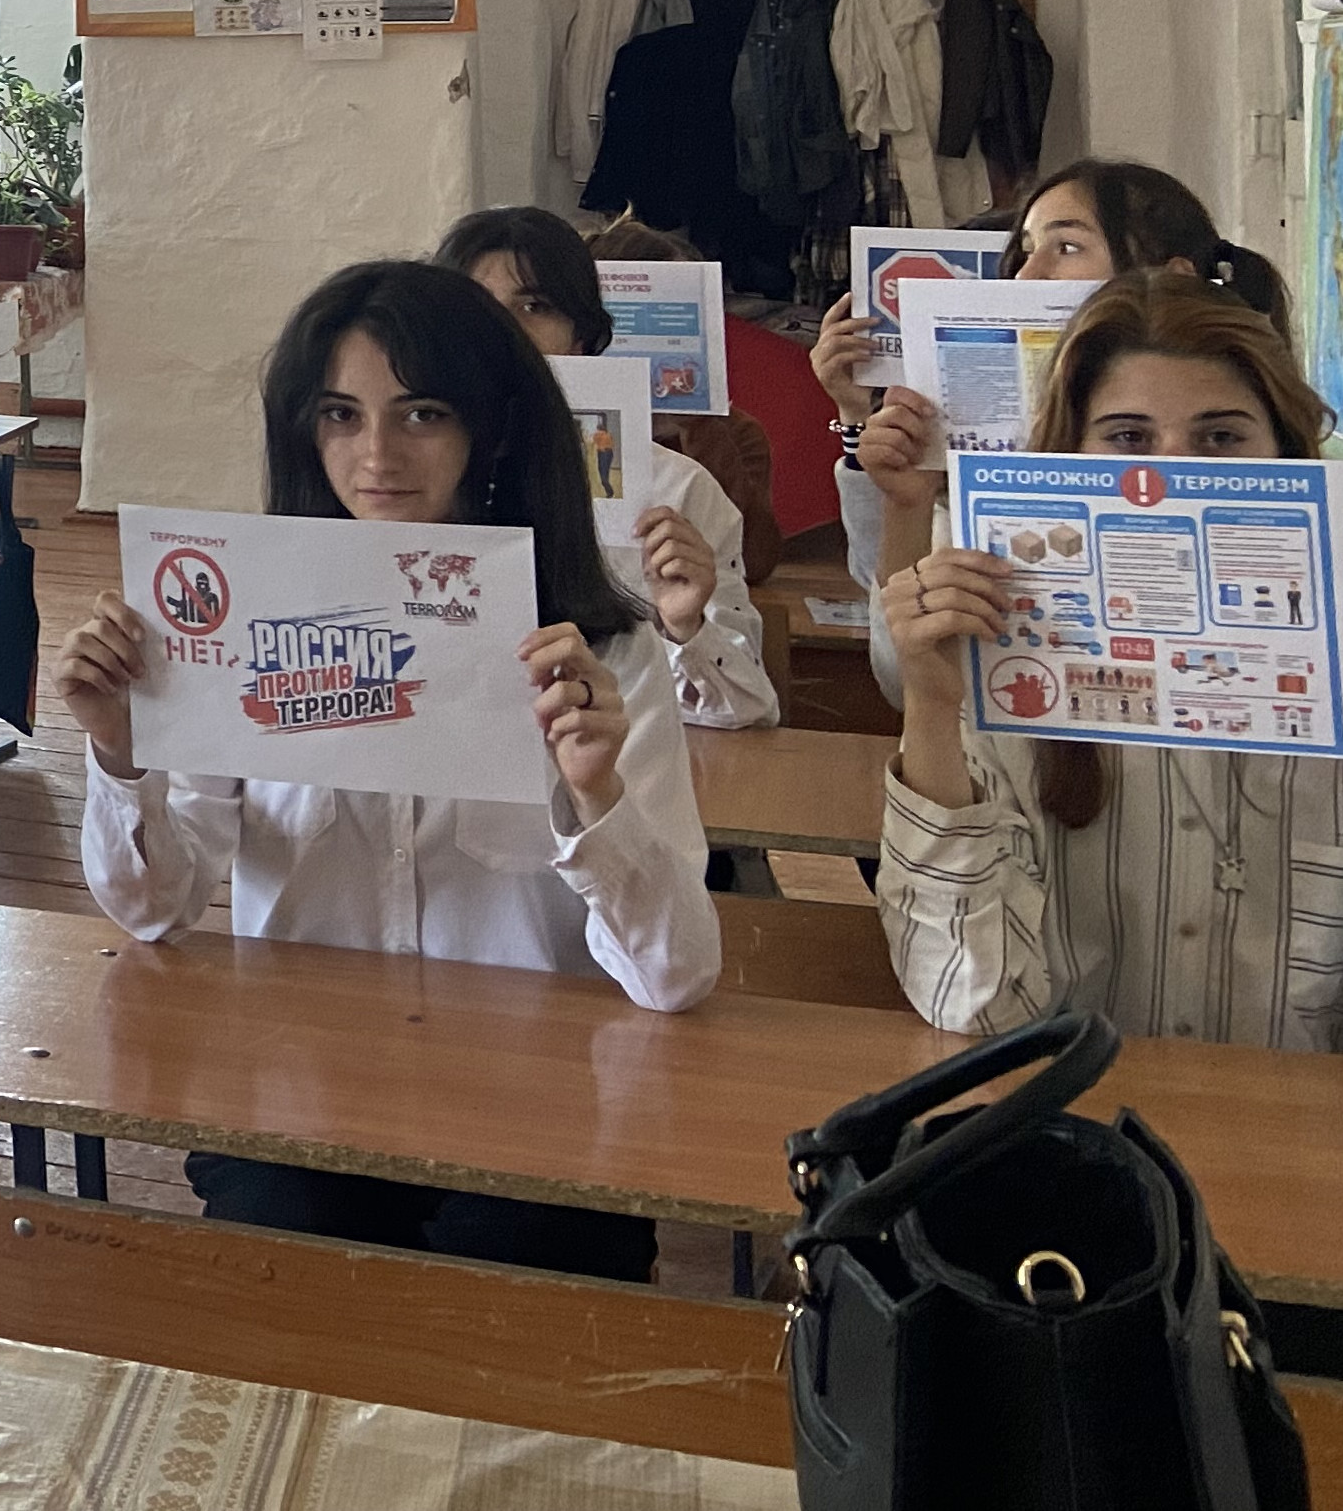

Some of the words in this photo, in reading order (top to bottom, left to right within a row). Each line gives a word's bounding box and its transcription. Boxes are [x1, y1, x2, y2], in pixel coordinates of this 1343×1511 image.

[975, 468, 1114, 488] ОСТОРОЖНО
[1171, 473, 1310, 494] ТЕРРОРИЗМ
[150, 531, 227, 548] ТЕРРОРИЗМУ
[402, 602, 479, 619] TERRORISM
[253, 620, 395, 681] РОССИЯ
[257, 664, 354, 701] ПРОТИВ
[277, 691, 396, 726] ТЕРРОРА!
